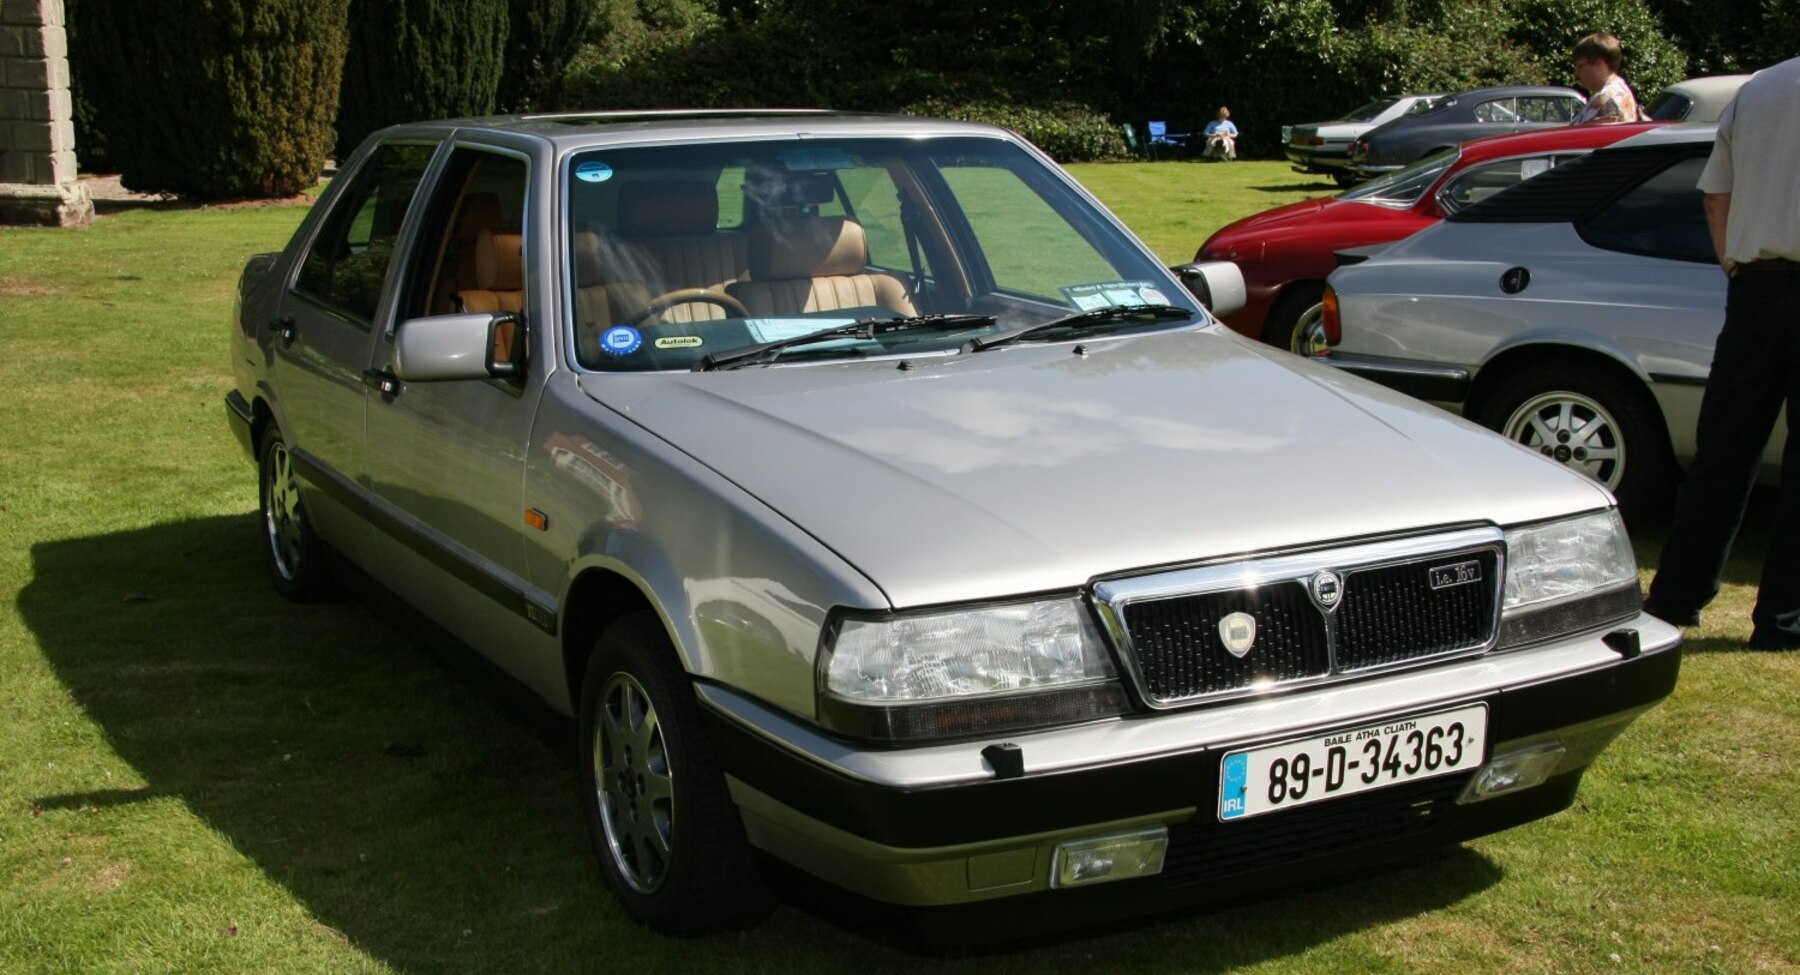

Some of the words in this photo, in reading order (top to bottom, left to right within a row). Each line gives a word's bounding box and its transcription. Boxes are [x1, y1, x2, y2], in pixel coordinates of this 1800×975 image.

[660, 338, 699, 346] Autolok
[1454, 564, 1475, 582] 16v
[1324, 734, 1353, 747] BAILE
[1384, 721, 1417, 735] CLIATH
[1267, 721, 1465, 804] 89-D-34363
[1223, 797, 1245, 813] IRL
